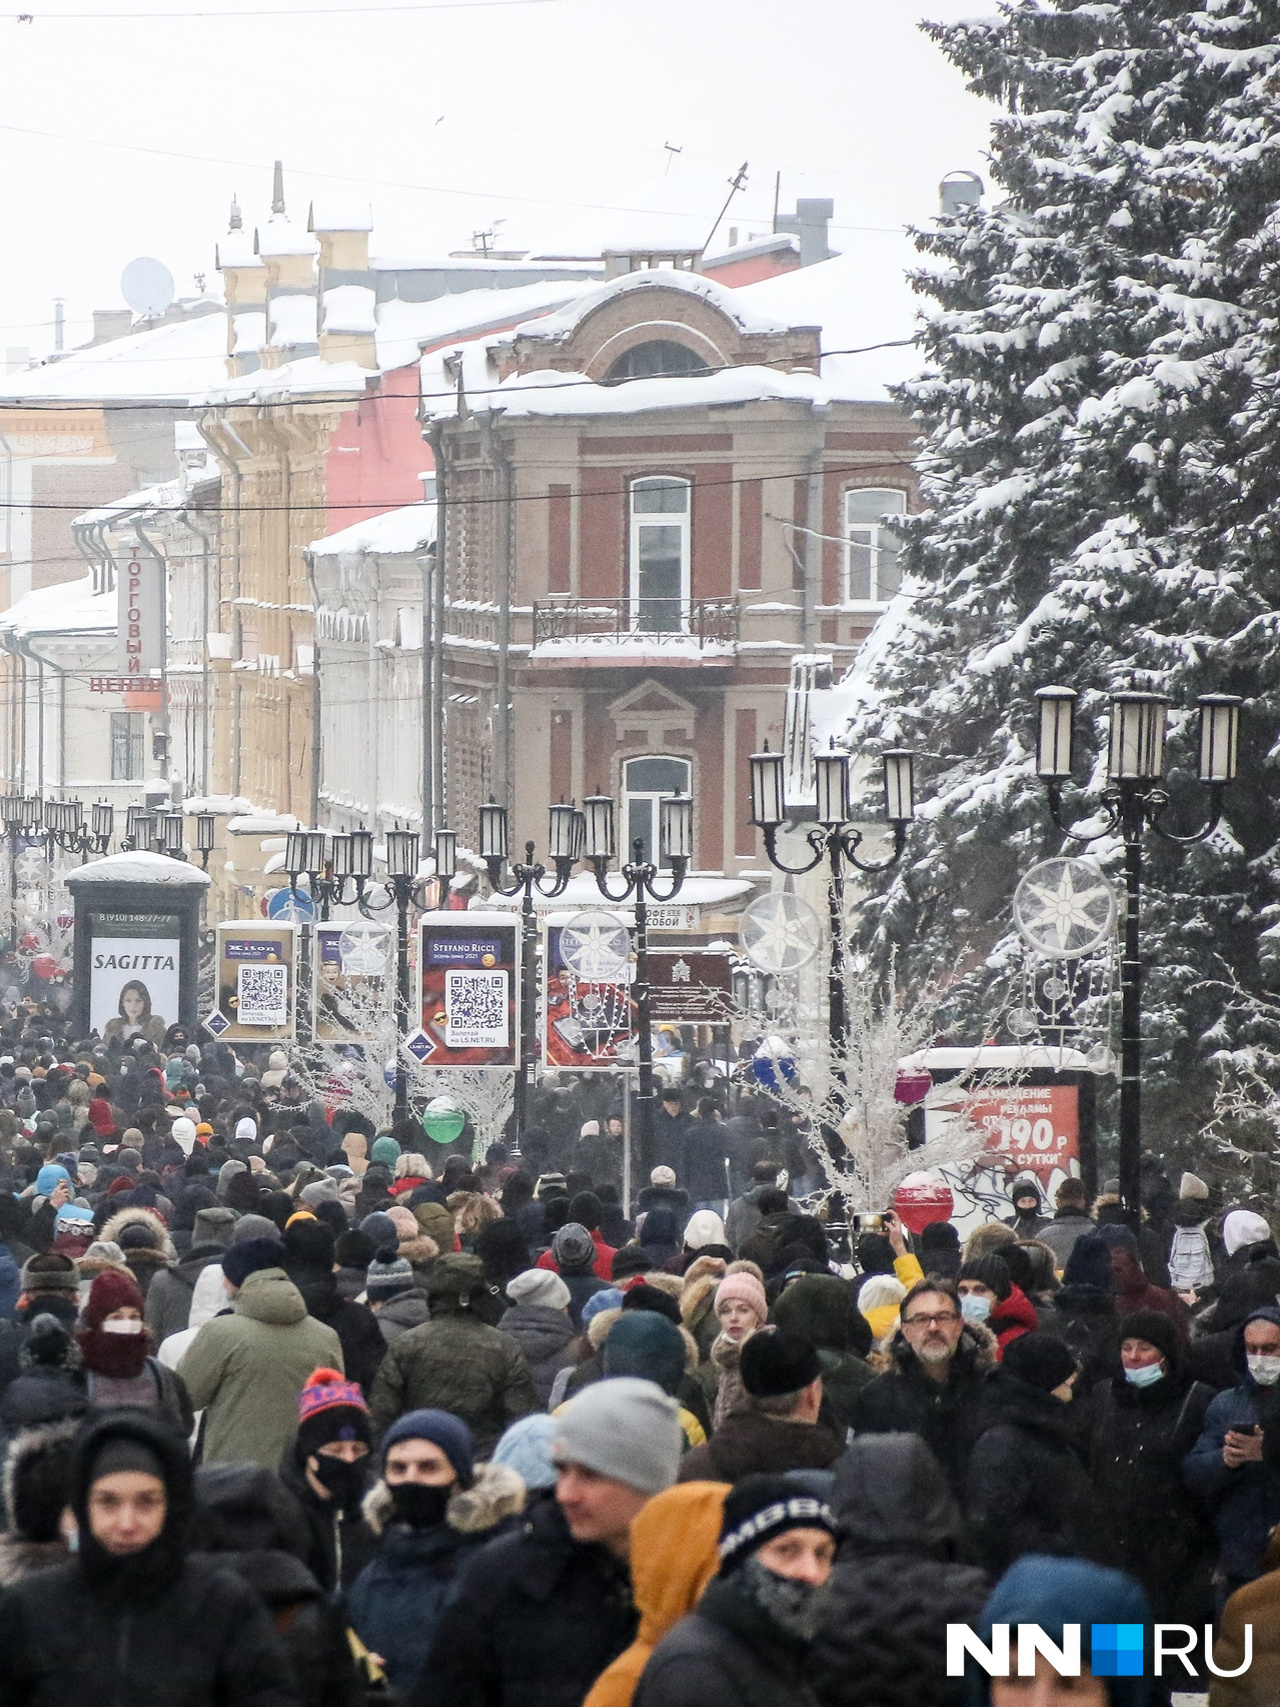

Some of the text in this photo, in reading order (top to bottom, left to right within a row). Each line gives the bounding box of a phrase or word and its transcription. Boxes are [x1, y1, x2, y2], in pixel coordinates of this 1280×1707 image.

[126, 546, 142, 673] ТОРГОВЫЙ
[99, 913, 106, 921] 8
[228, 943, 276, 952] Kiton
[93, 954, 175, 971] SAGITTA
[1000, 1118, 1054, 1150] 190
